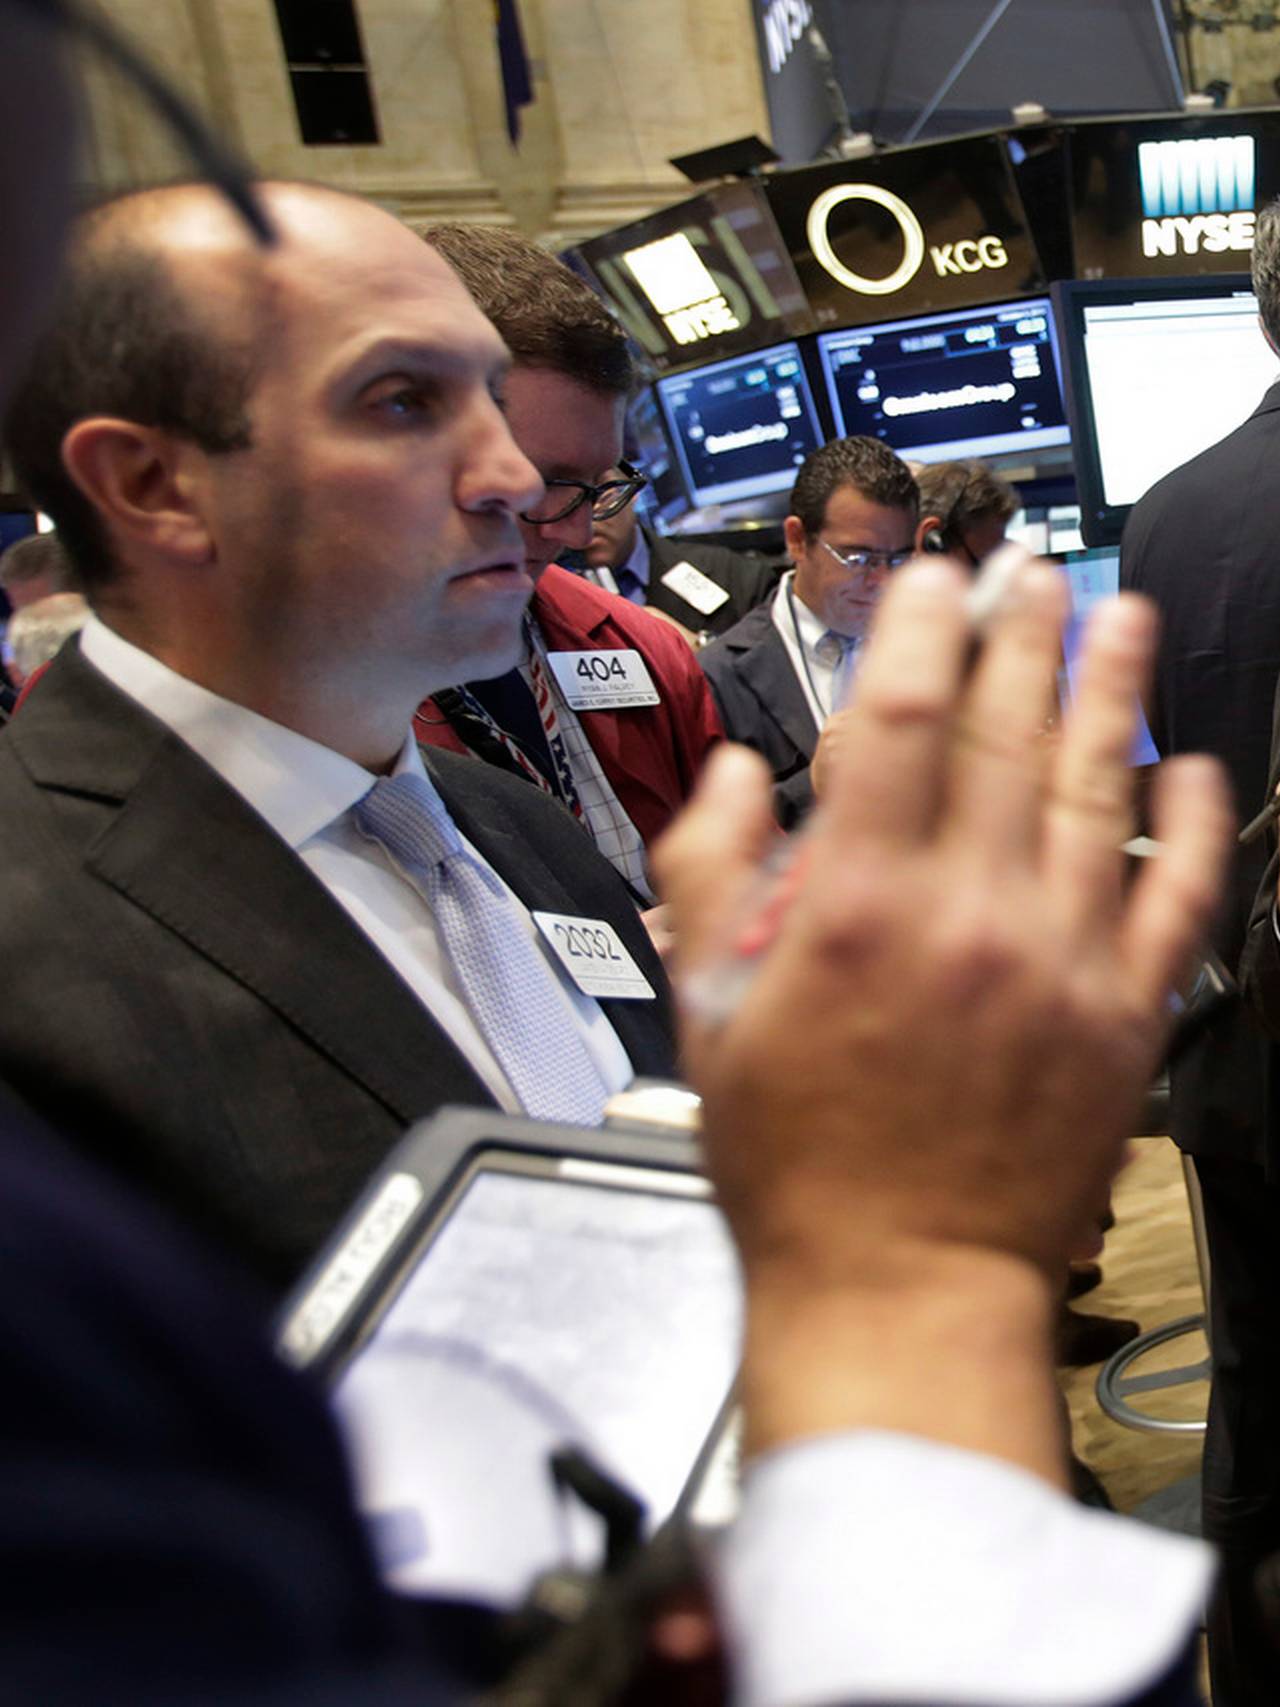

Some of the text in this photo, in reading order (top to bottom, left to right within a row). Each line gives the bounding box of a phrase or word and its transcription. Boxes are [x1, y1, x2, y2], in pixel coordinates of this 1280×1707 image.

[1142, 211, 1257, 258] NYSE
[930, 235, 1009, 277] KCG
[663, 296, 740, 345] NYSE
[577, 657, 626, 681] 404
[553, 923, 622, 961] 2032
